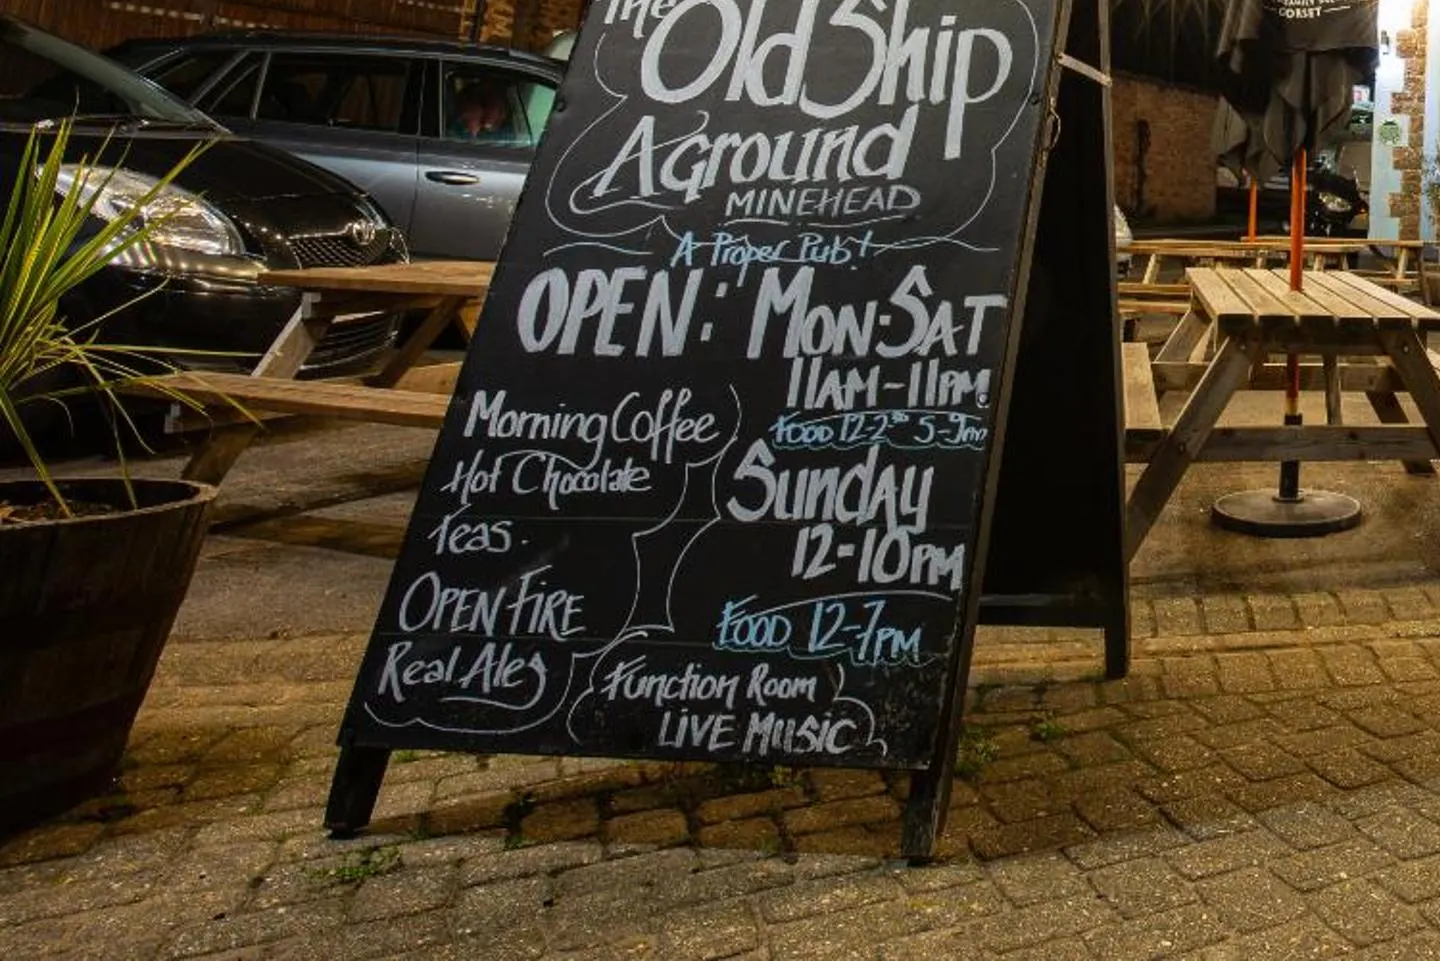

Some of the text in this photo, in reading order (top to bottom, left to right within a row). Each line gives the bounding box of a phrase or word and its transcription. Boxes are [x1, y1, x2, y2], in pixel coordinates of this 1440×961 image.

[592, 103, 920, 204] Aground
[723, 185, 922, 218] MINEHEAD
[670, 231, 697, 267] A
[710, 231, 790, 288] Proper
[464, 389, 721, 470] Morning Coffee
[440, 448, 652, 510] Hot Chocolate
[400, 571, 507, 637] OPEN
[716, 595, 792, 646] FOOD
[379, 641, 462, 703] Real
[601, 654, 818, 710] Function Room
